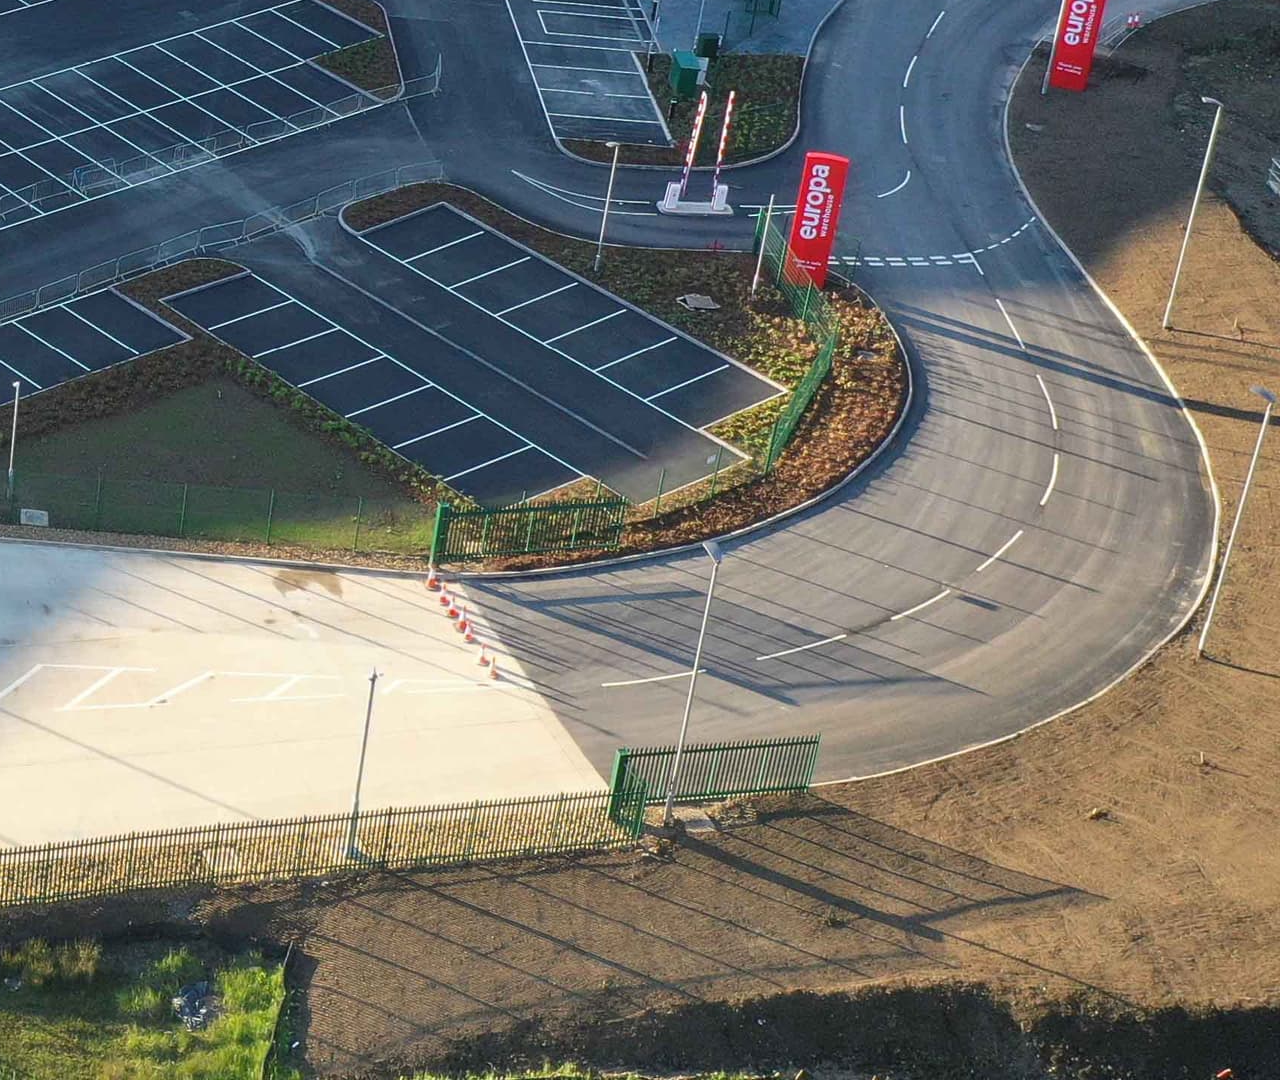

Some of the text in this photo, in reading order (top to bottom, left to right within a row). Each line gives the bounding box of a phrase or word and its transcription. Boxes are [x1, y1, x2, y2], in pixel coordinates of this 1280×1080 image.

[1082, 5, 1097, 44] warehouse
[800, 164, 831, 240] europa
[819, 195, 834, 238] warehouse
